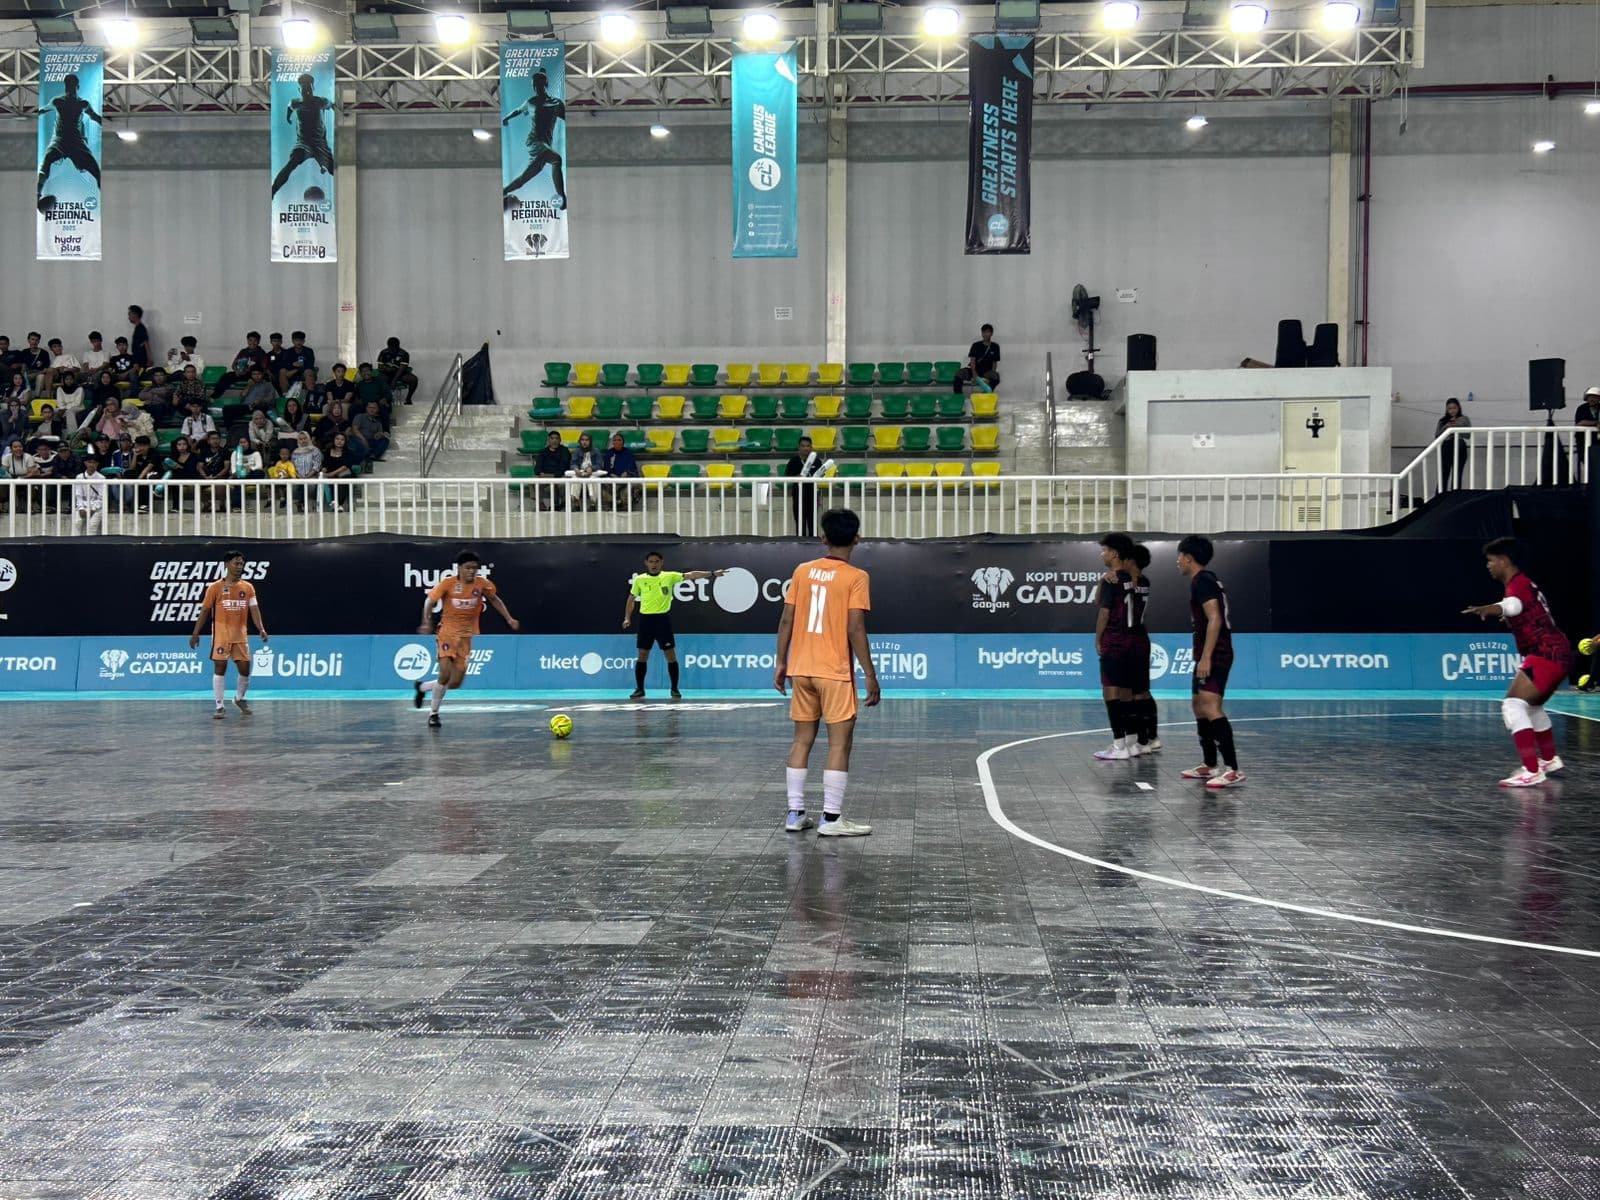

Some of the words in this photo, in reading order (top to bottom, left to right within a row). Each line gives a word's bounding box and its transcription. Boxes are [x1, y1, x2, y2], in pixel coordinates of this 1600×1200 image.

[44, 54, 98, 64] GREATNESS
[276, 54, 330, 63] GREATNESS
[505, 48, 559, 58] GREATNESS
[44, 63, 81, 73] STARTS
[276, 63, 313, 73] STARTS
[505, 58, 542, 68] STARTS
[505, 68, 530, 78] HERE
[1002, 76, 1019, 124] HERE
[753, 103, 765, 155] CAMPUS
[764, 111, 776, 158] LEAGUE
[982, 102, 1000, 205] GREATNESS
[1000, 130, 1018, 199] STARTS
[54, 202, 85, 210] FUTSAL
[288, 204, 320, 212] FUTSAL
[519, 201, 551, 209] FUTSAL
[45, 210, 94, 222] REGIONAL
[280, 212, 329, 224] REGIONAL
[512, 209, 560, 221] REGIONAL
[1026, 572, 1057, 582] KOPI
[807, 584, 827, 634] 11
[871, 643, 901, 651] ELIZIO
[1469, 641, 1508, 651] DELIZIO
[136, 652, 158, 660] KOPI
[161, 652, 197, 660] TUBRUK
[685, 654, 777, 668] POLYTRO
[978, 647, 1084, 669] hydroplus
[1280, 654, 1390, 669] POLYTRON
[129, 661, 203, 674] GADJAH
[278, 653, 343, 677] blibli
[1441, 653, 1525, 681] CAFFIN
